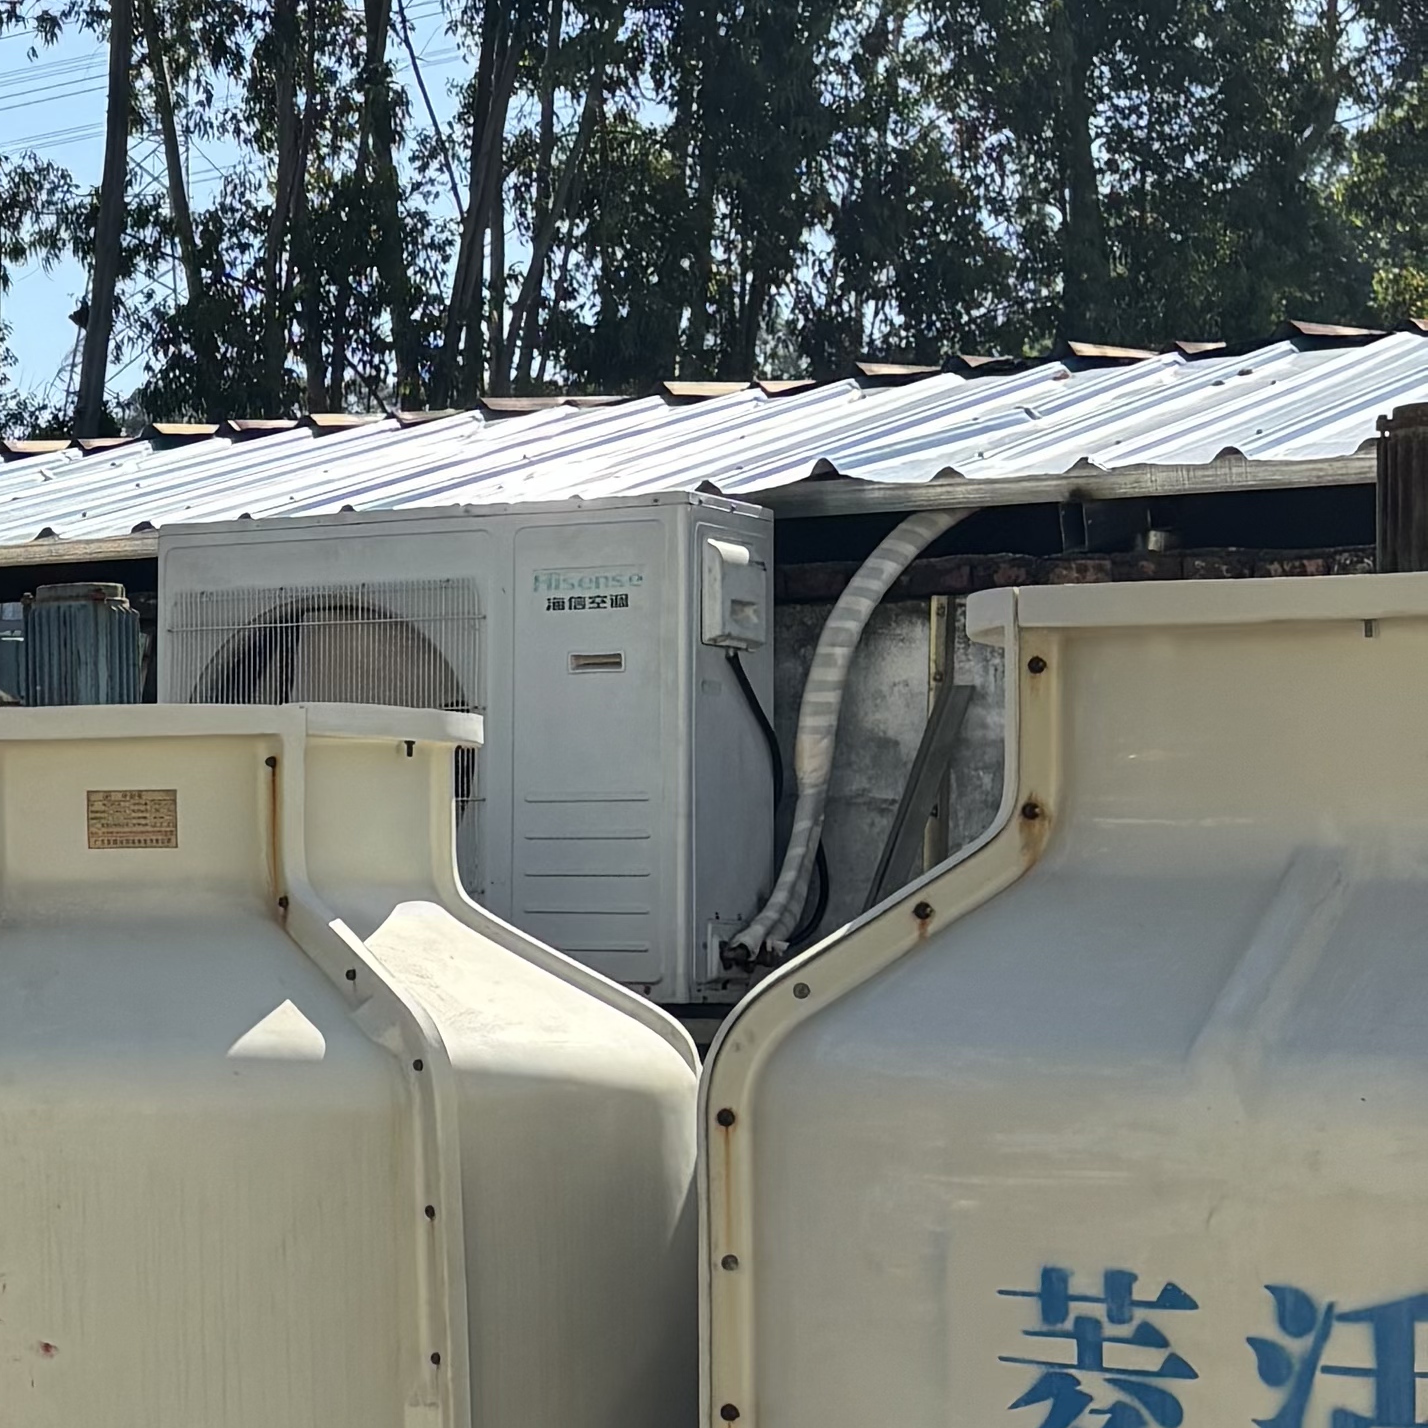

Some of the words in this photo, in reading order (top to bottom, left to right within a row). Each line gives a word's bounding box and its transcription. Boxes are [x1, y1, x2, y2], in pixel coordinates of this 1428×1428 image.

[533, 572, 643, 592] Hisense
[546, 593, 629, 611] 海信空调
